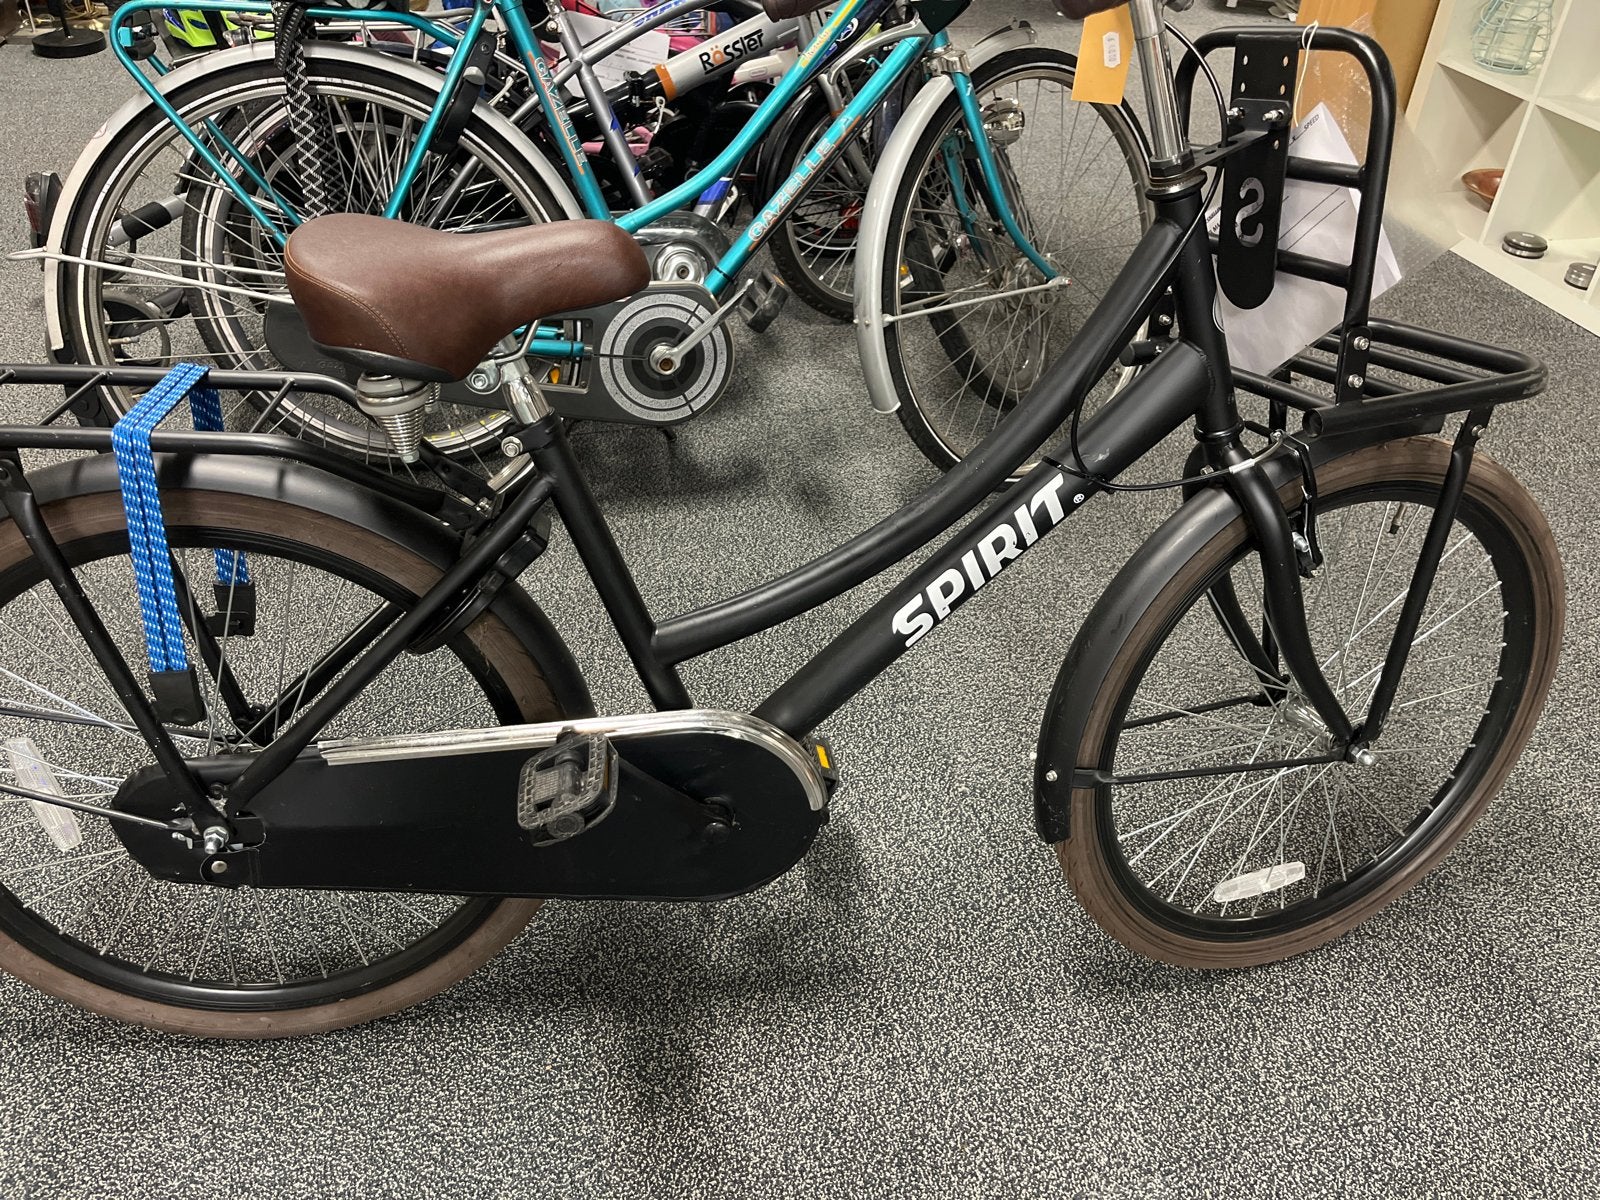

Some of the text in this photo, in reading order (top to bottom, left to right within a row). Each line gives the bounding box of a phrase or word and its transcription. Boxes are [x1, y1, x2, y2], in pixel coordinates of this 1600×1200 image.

[534, 57, 587, 166] GAZELLE
[1303, 114, 1320, 131] SPEED
[748, 138, 837, 242] GAZELLE
[892, 472, 1064, 648] SPIRIT
